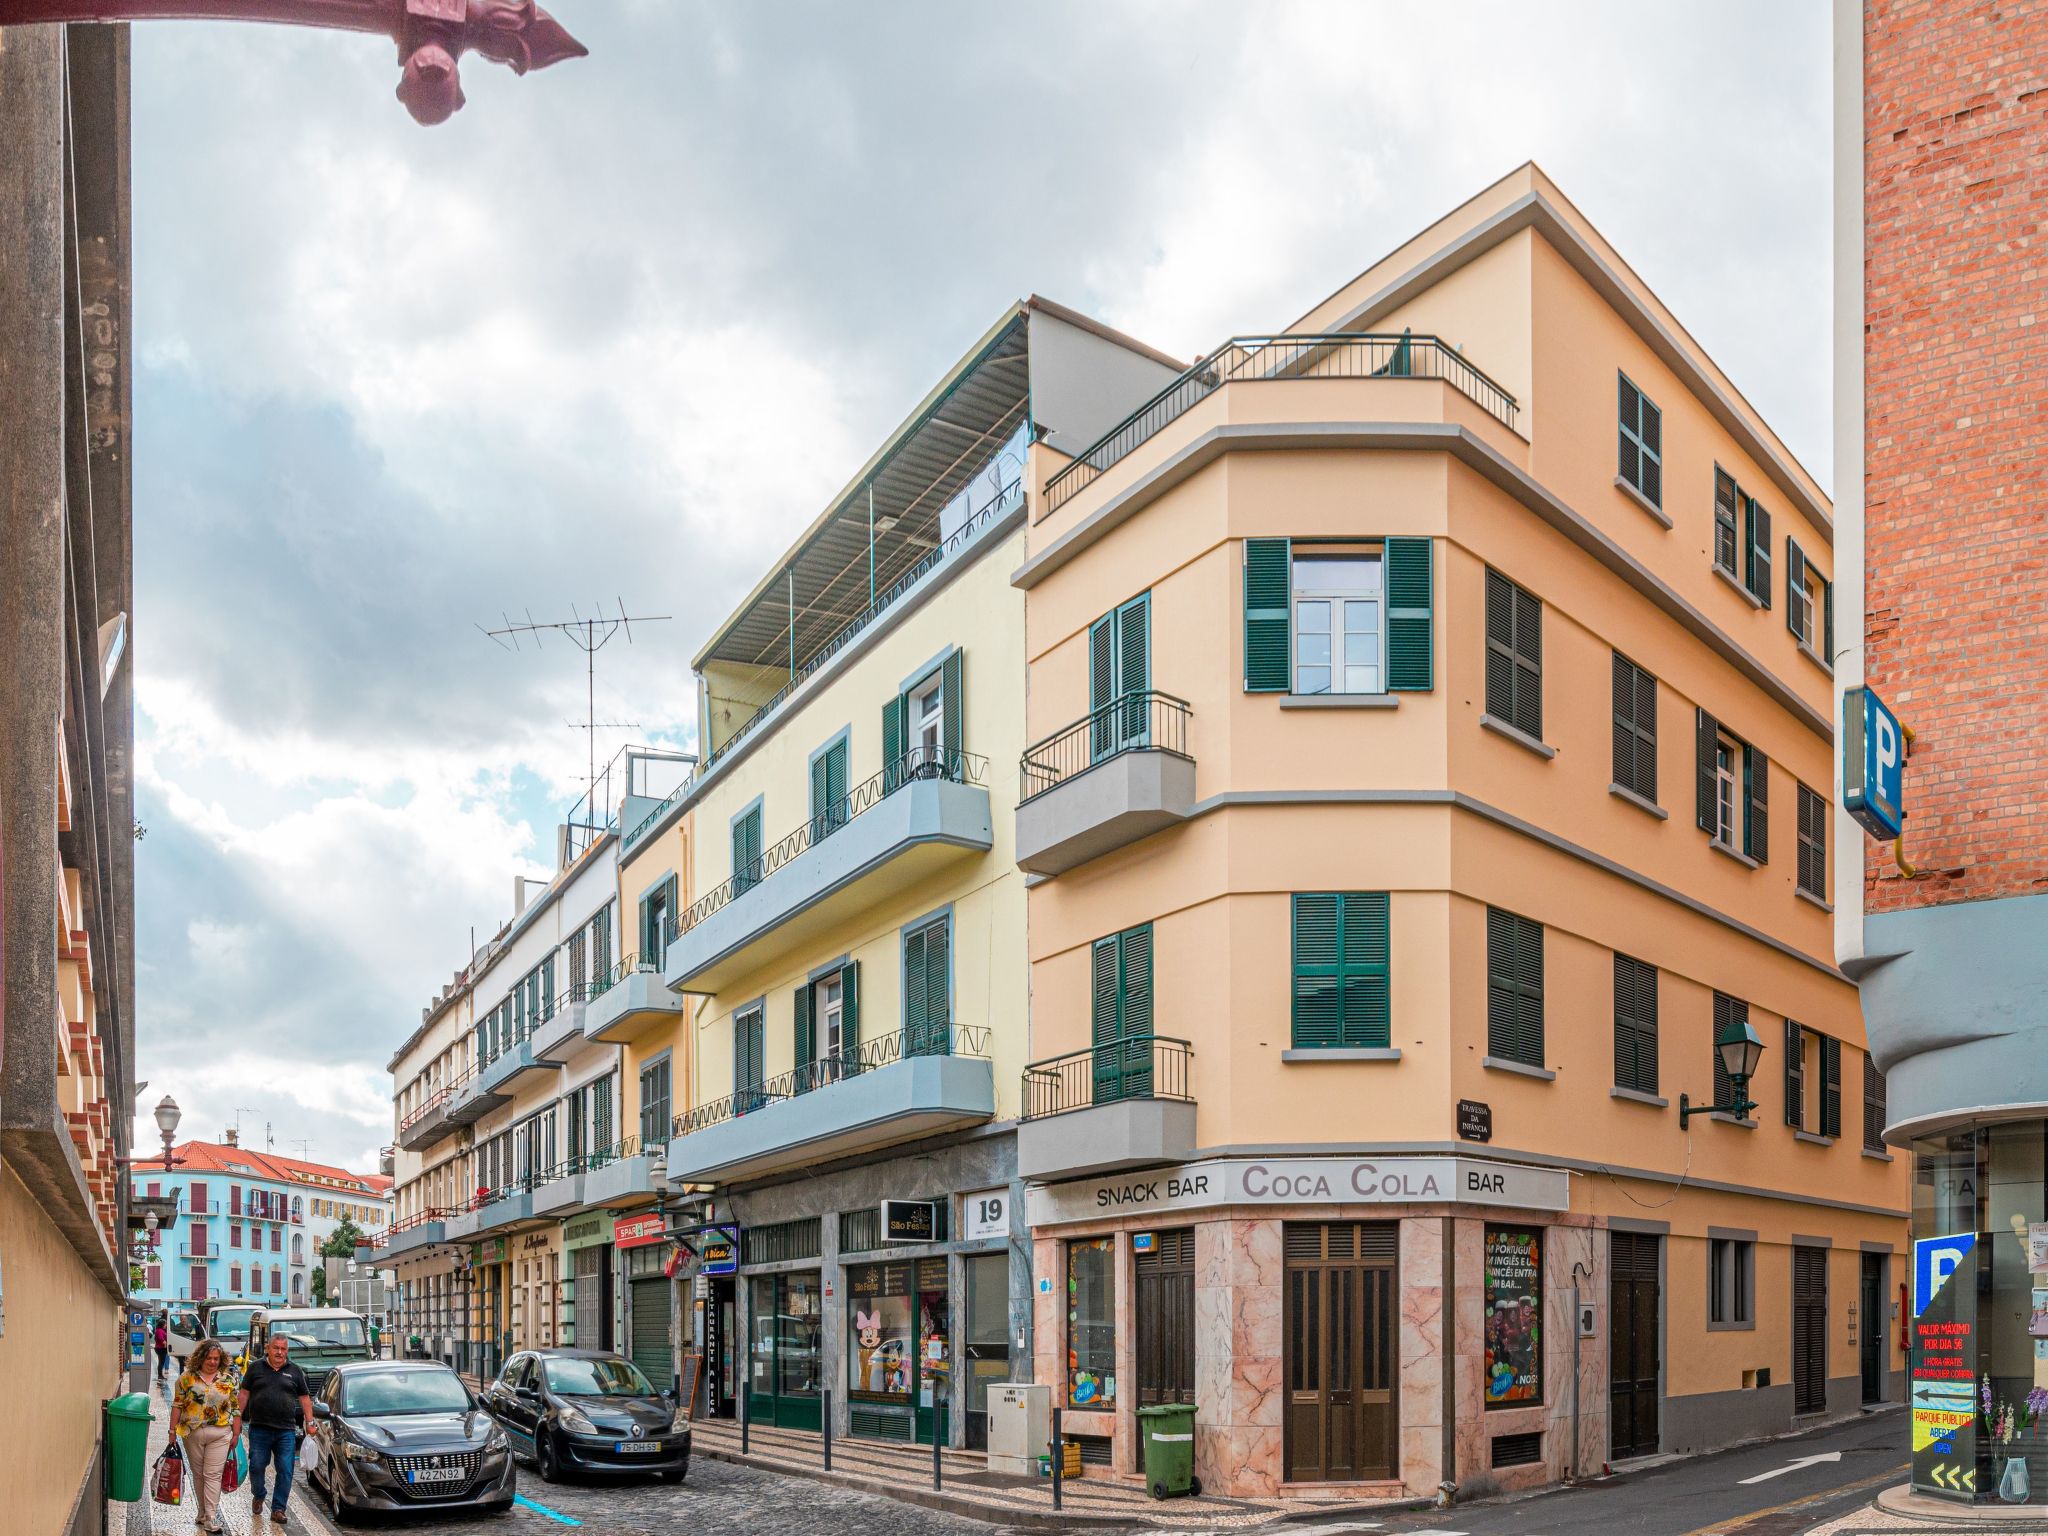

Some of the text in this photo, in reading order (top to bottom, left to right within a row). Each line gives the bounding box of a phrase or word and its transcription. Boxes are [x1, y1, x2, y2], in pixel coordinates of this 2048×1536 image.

[1462, 1104, 1488, 1115] TRAVESSA
[1470, 1114, 1479, 1122] DA
[1462, 1122, 1488, 1133] INFÂNCIA
[1467, 1171, 1505, 1194] BAR
[1096, 1175, 1209, 1207] SNACK BAR
[979, 1198, 1003, 1224] 19
[890, 1220, 906, 1230] São
[620, 1226, 636, 1238] SPAR
[1495, 1255, 1519, 1266] INGLÊS
[1521, 1257, 1526, 1266] E
[1918, 1320, 1970, 1336] VALOR MÁXIMO
[1924, 1338, 1938, 1350] POR
[1939, 1338, 1952, 1350] DIA
[1927, 1357, 1942, 1367] HORA
[709, 1369, 715, 1377] A
[1915, 1411, 1972, 1427] PARQUE PÚBLICO
[1933, 1442, 1952, 1454] OPEN
